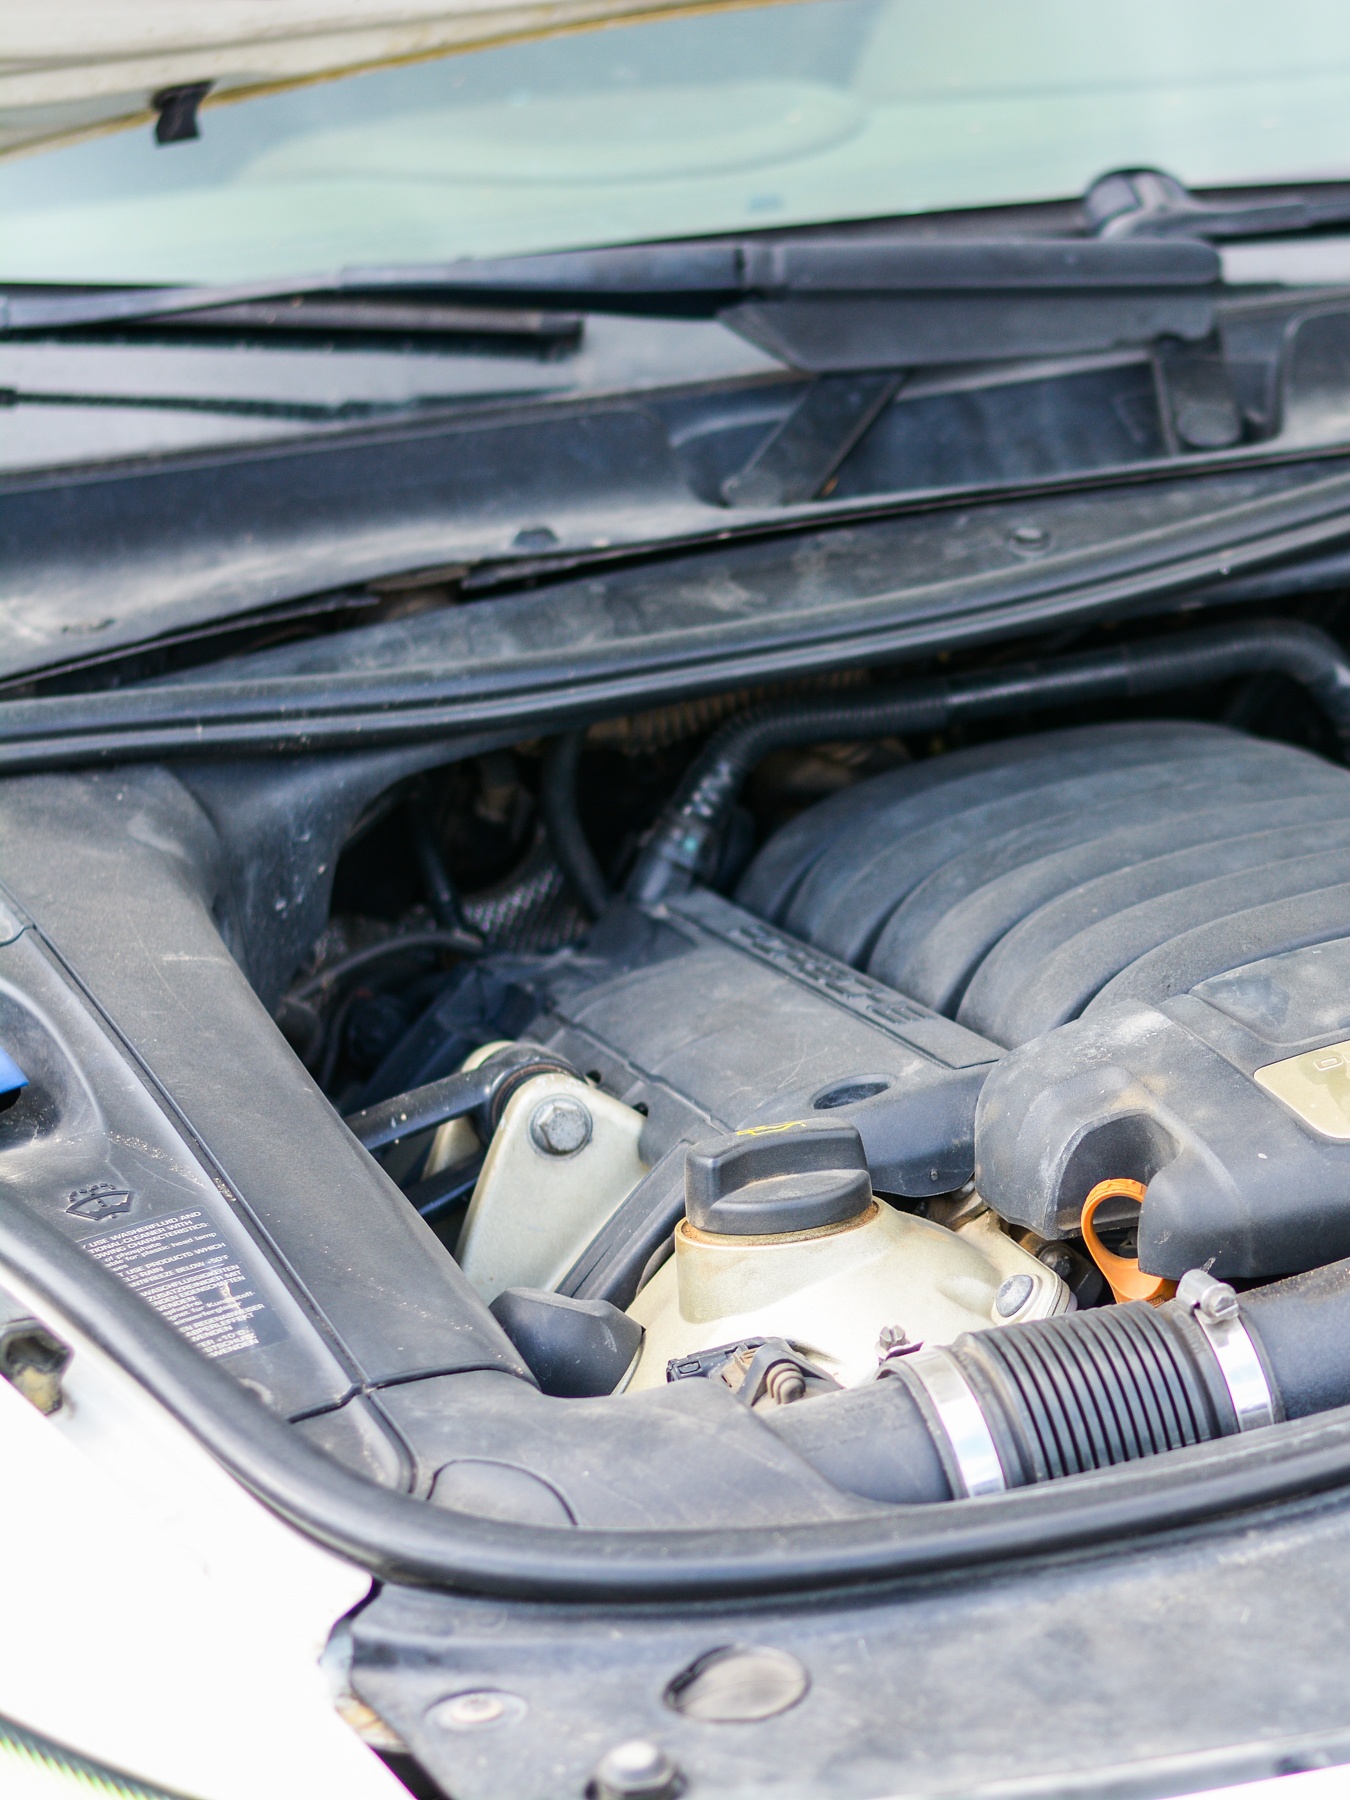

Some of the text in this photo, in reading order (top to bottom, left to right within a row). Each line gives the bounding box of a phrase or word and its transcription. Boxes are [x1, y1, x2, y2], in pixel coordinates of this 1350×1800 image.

[88, 1210, 202, 1247] USE WASHERFLUID AND
[166, 1219, 192, 1230] WITH
[126, 1222, 209, 1248] CHARACTERISTICS:
[115, 1242, 162, 1258] phosphate
[124, 1253, 139, 1261] for
[140, 1244, 171, 1257] plastic
[170, 1237, 194, 1247] head
[194, 1231, 217, 1241] lamp
[124, 1265, 145, 1274] USE
[145, 1251, 193, 1268] PRODUCTS
[194, 1241, 225, 1254] WHICH
[138, 1266, 164, 1277] RAIN
[175, 1261, 204, 1273] BELOW
[224, 1269, 242, 1278] MIT
